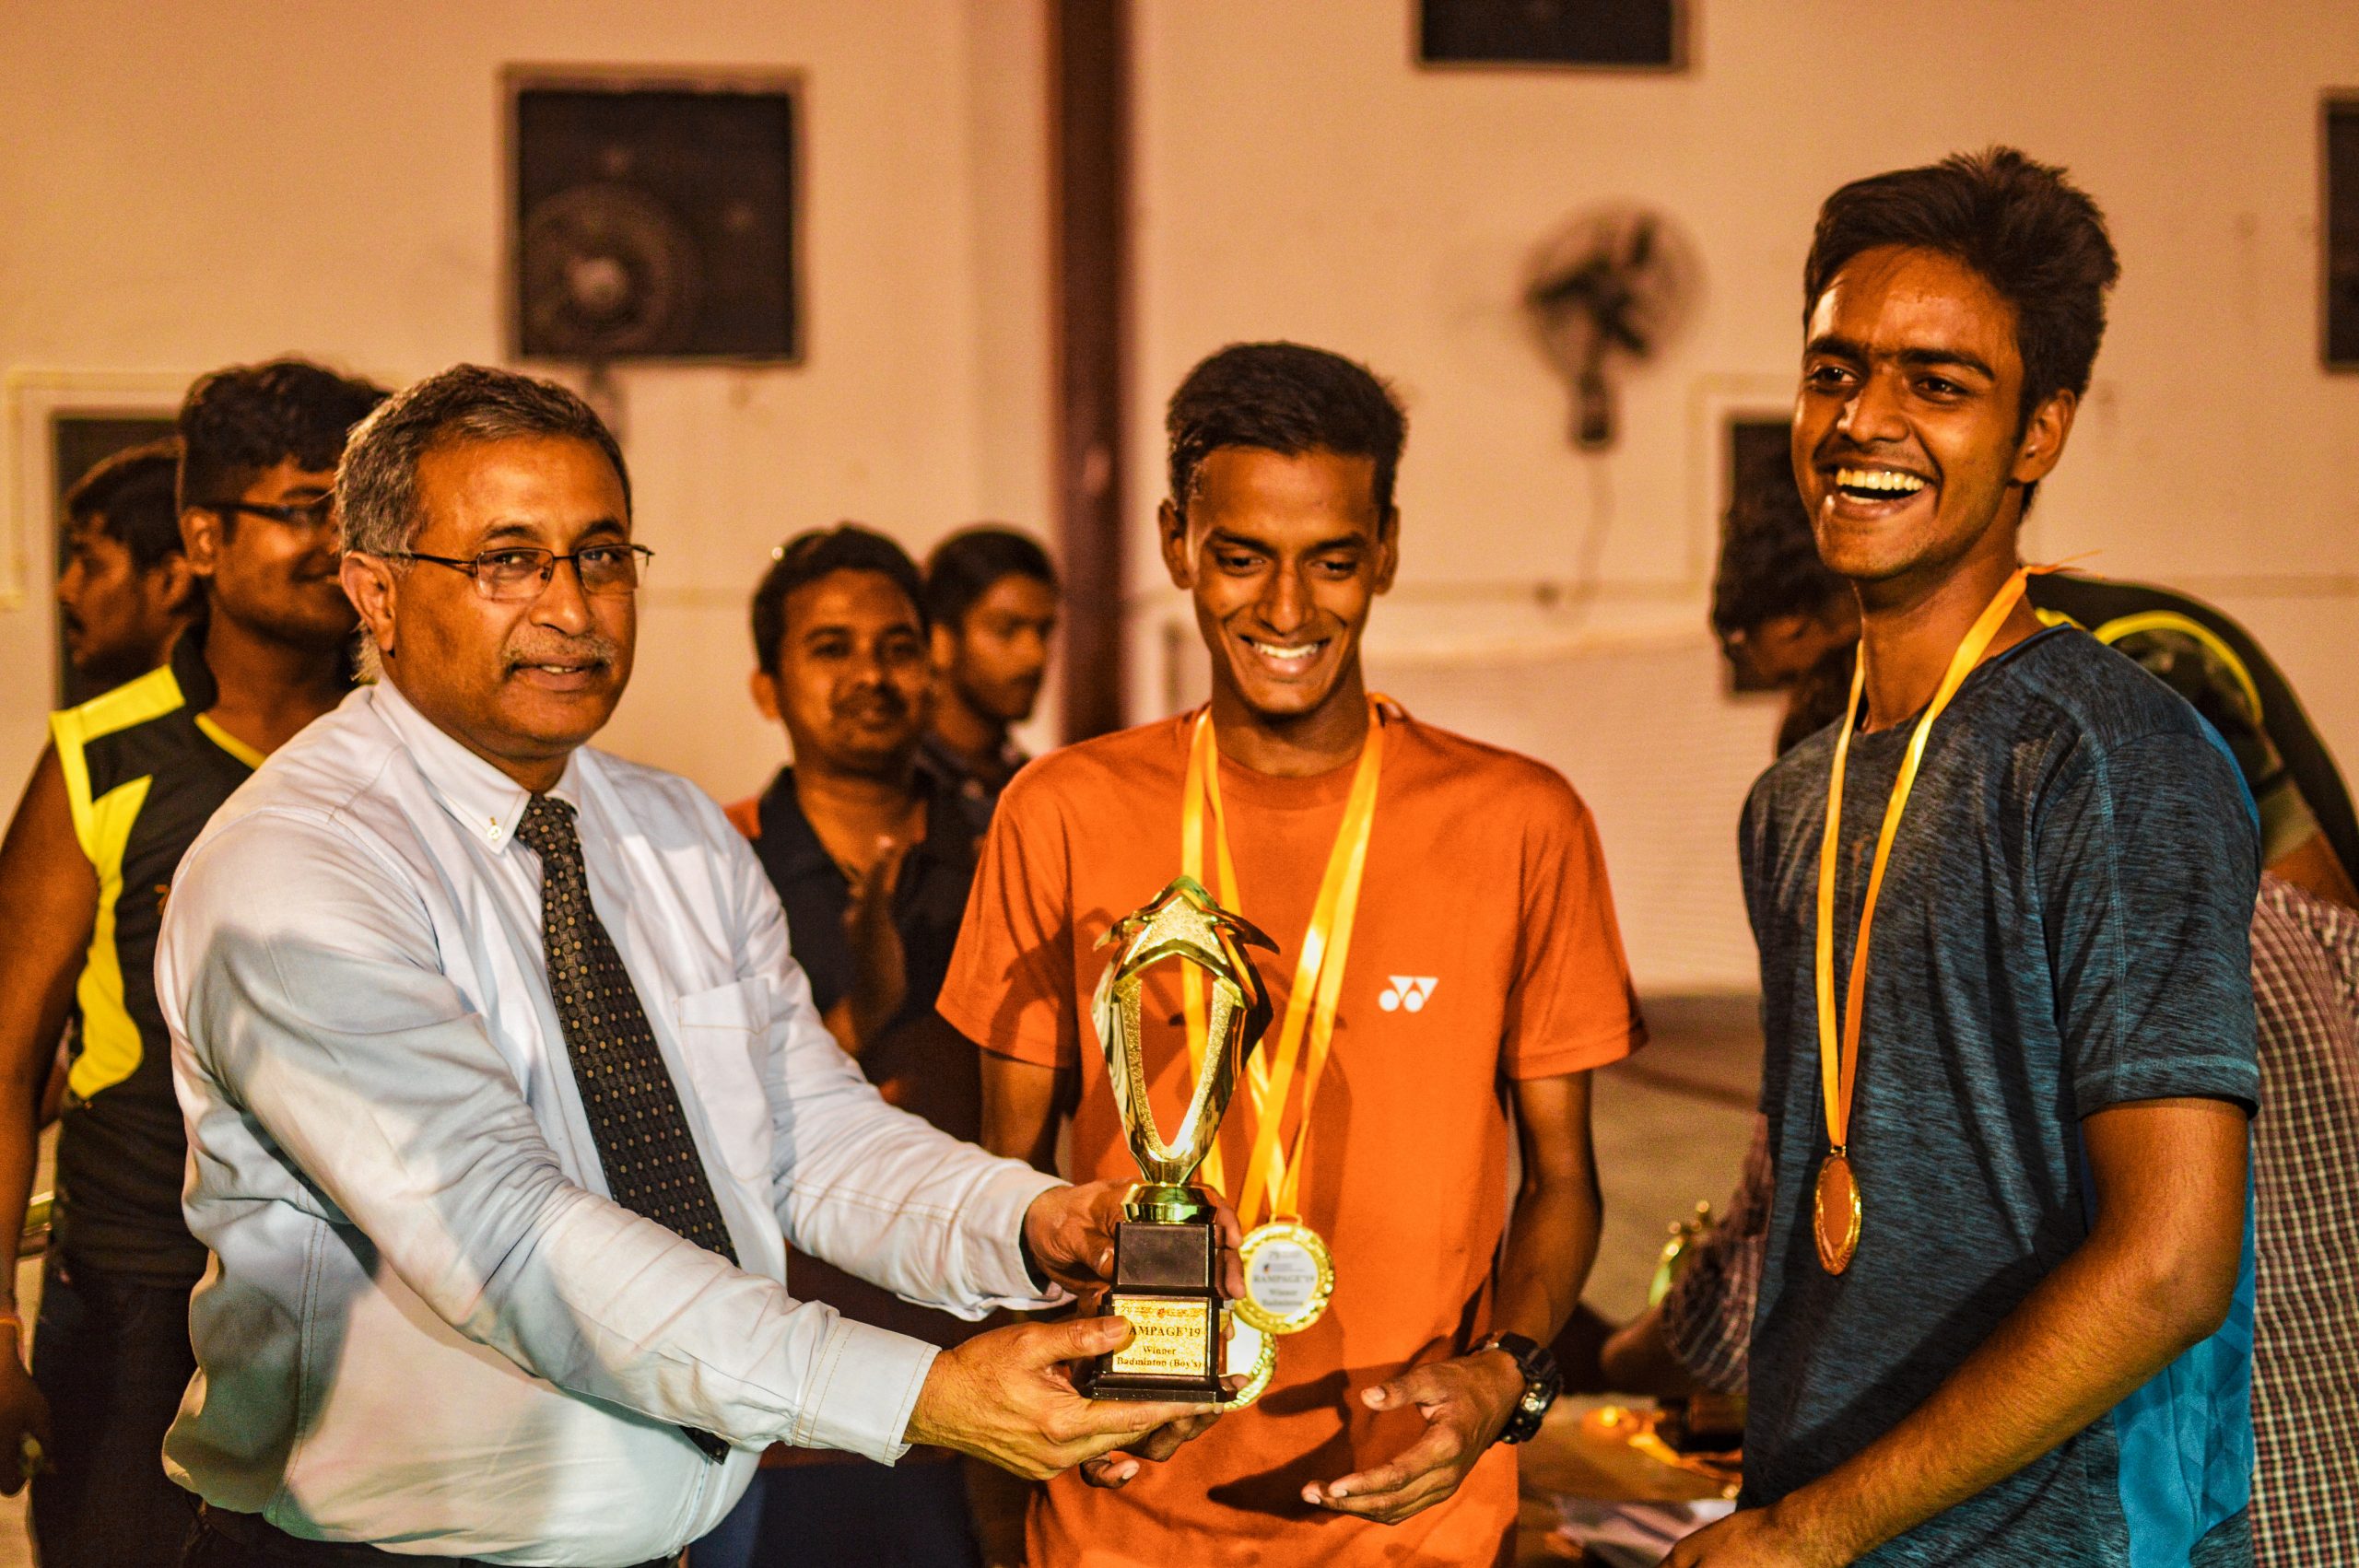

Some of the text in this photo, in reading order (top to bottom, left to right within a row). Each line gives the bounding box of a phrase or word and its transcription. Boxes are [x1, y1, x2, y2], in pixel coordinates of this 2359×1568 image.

[1129, 1326, 1201, 1337] AMPAGE'19
[1143, 1345, 1177, 1355] Winner
[1117, 1356, 1167, 1367] Badminton
